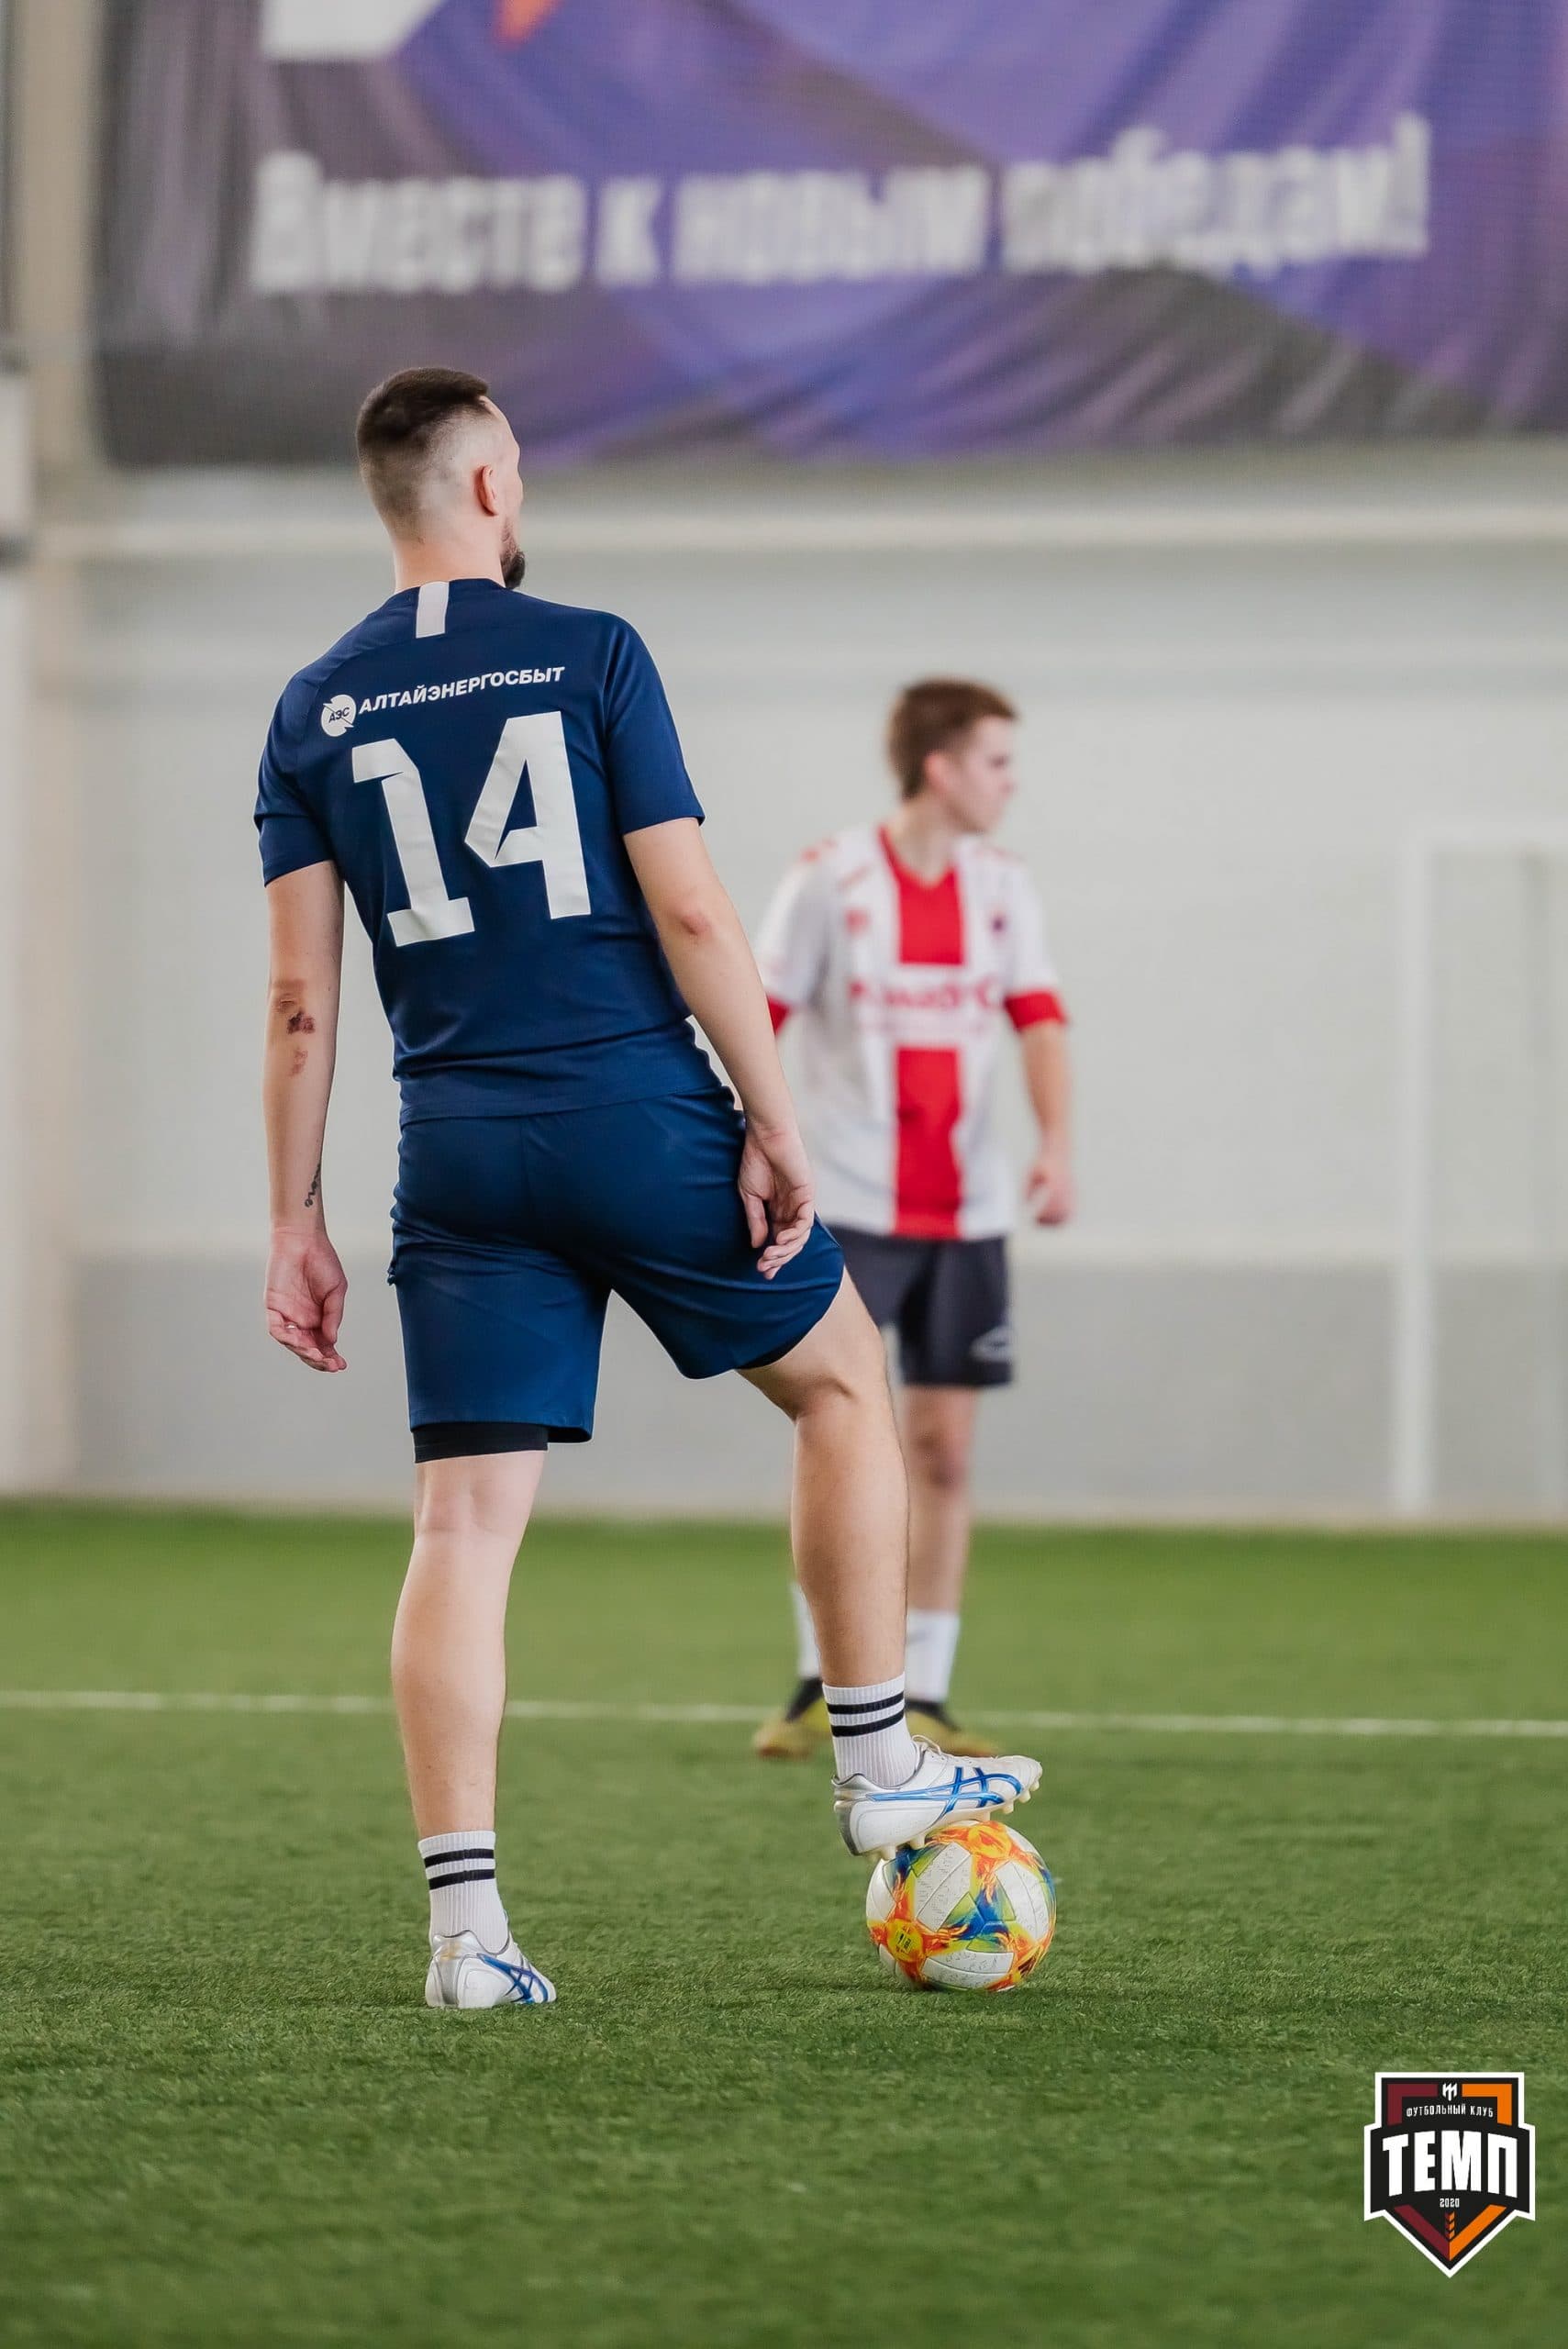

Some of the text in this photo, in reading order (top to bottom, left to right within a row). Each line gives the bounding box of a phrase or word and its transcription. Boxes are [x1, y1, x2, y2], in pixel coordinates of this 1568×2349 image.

[328, 666, 565, 723] АЭС АЛТАЙЭНЕРГОСБЫТ
[352, 711, 592, 947] 14
